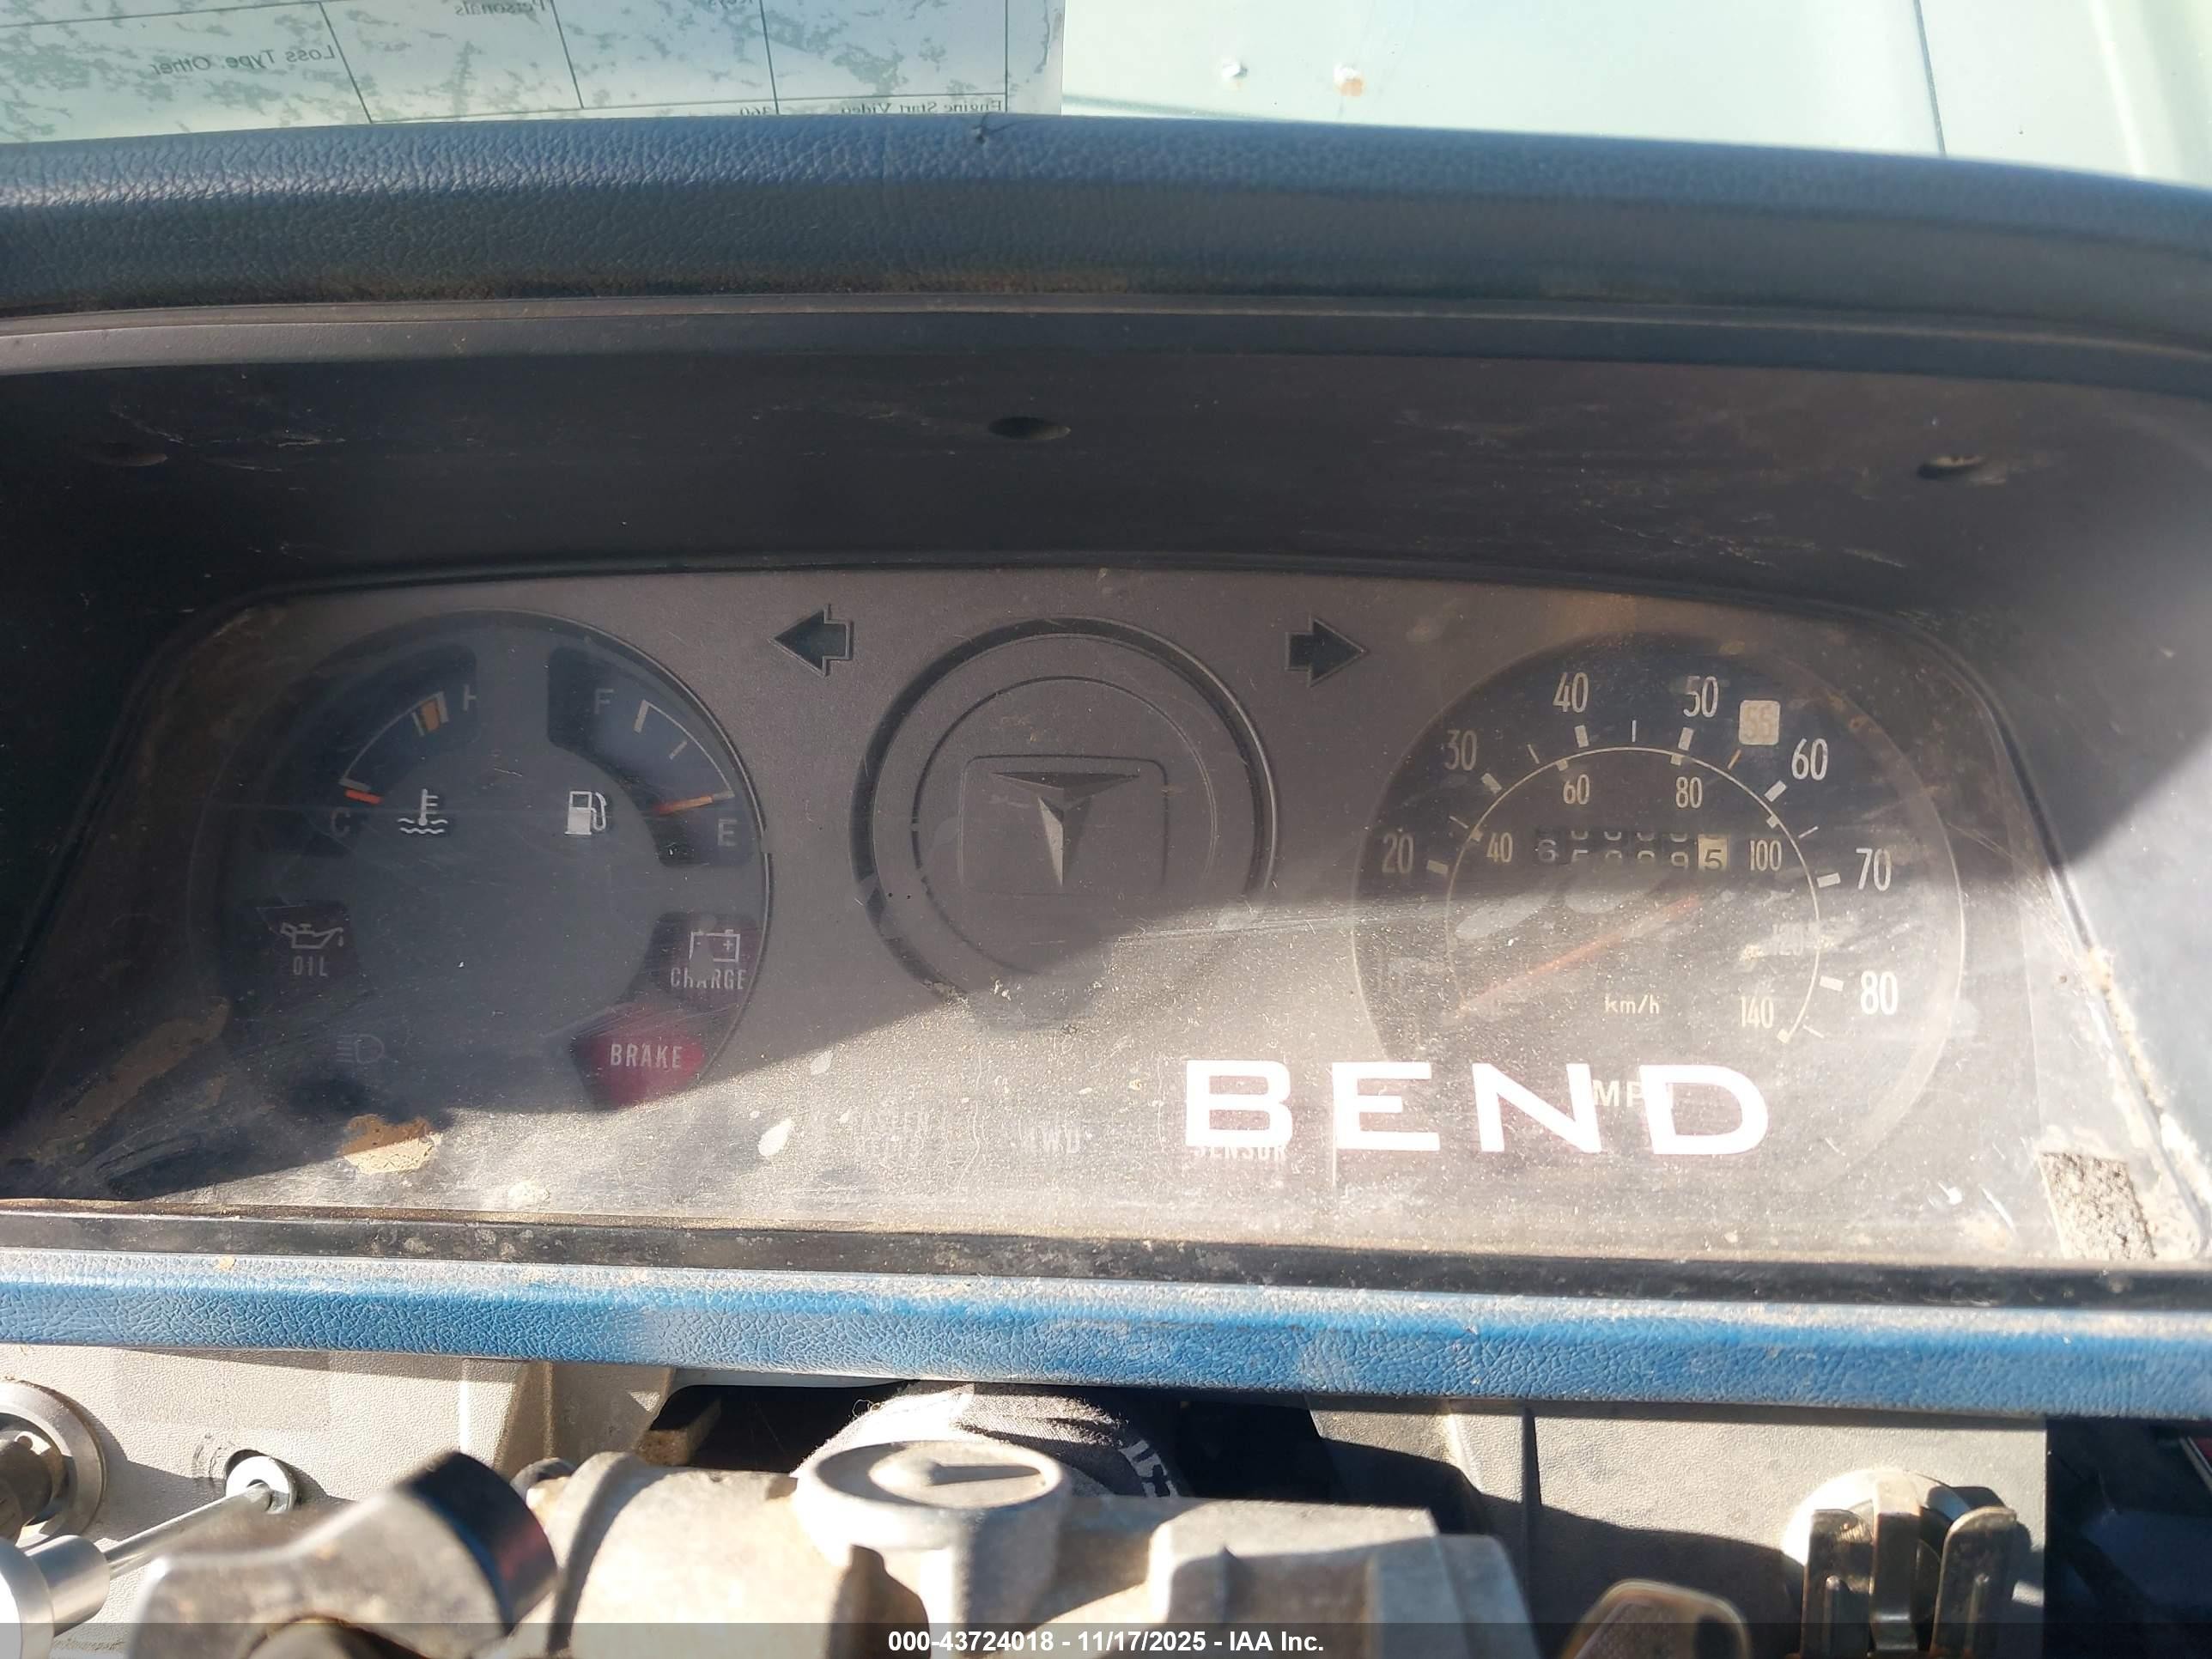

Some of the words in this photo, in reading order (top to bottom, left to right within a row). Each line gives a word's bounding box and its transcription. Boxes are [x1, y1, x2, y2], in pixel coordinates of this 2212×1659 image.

[594, 688, 615, 714] F
[1553, 672, 1589, 713] 40
[1683, 675, 1718, 718] 50
[1444, 730, 1478, 771] 30
[1791, 738, 1828, 781] 60
[1562, 774, 1589, 805] 60
[1675, 776, 1703, 809] 80
[330, 807, 351, 837] C
[717, 818, 738, 847] E
[1381, 833, 1413, 874] 20
[1486, 832, 1514, 864] 40
[1749, 839, 1783, 872] 100
[1856, 848, 1893, 892] 70
[293, 956, 328, 977] OIL
[1604, 994, 1660, 1015] km/h
[1860, 970, 1899, 1016] 80
[1740, 995, 1774, 1030] 140
[610, 1042, 683, 1069] BRAKE
[1185, 1059, 1769, 1155] BEND
